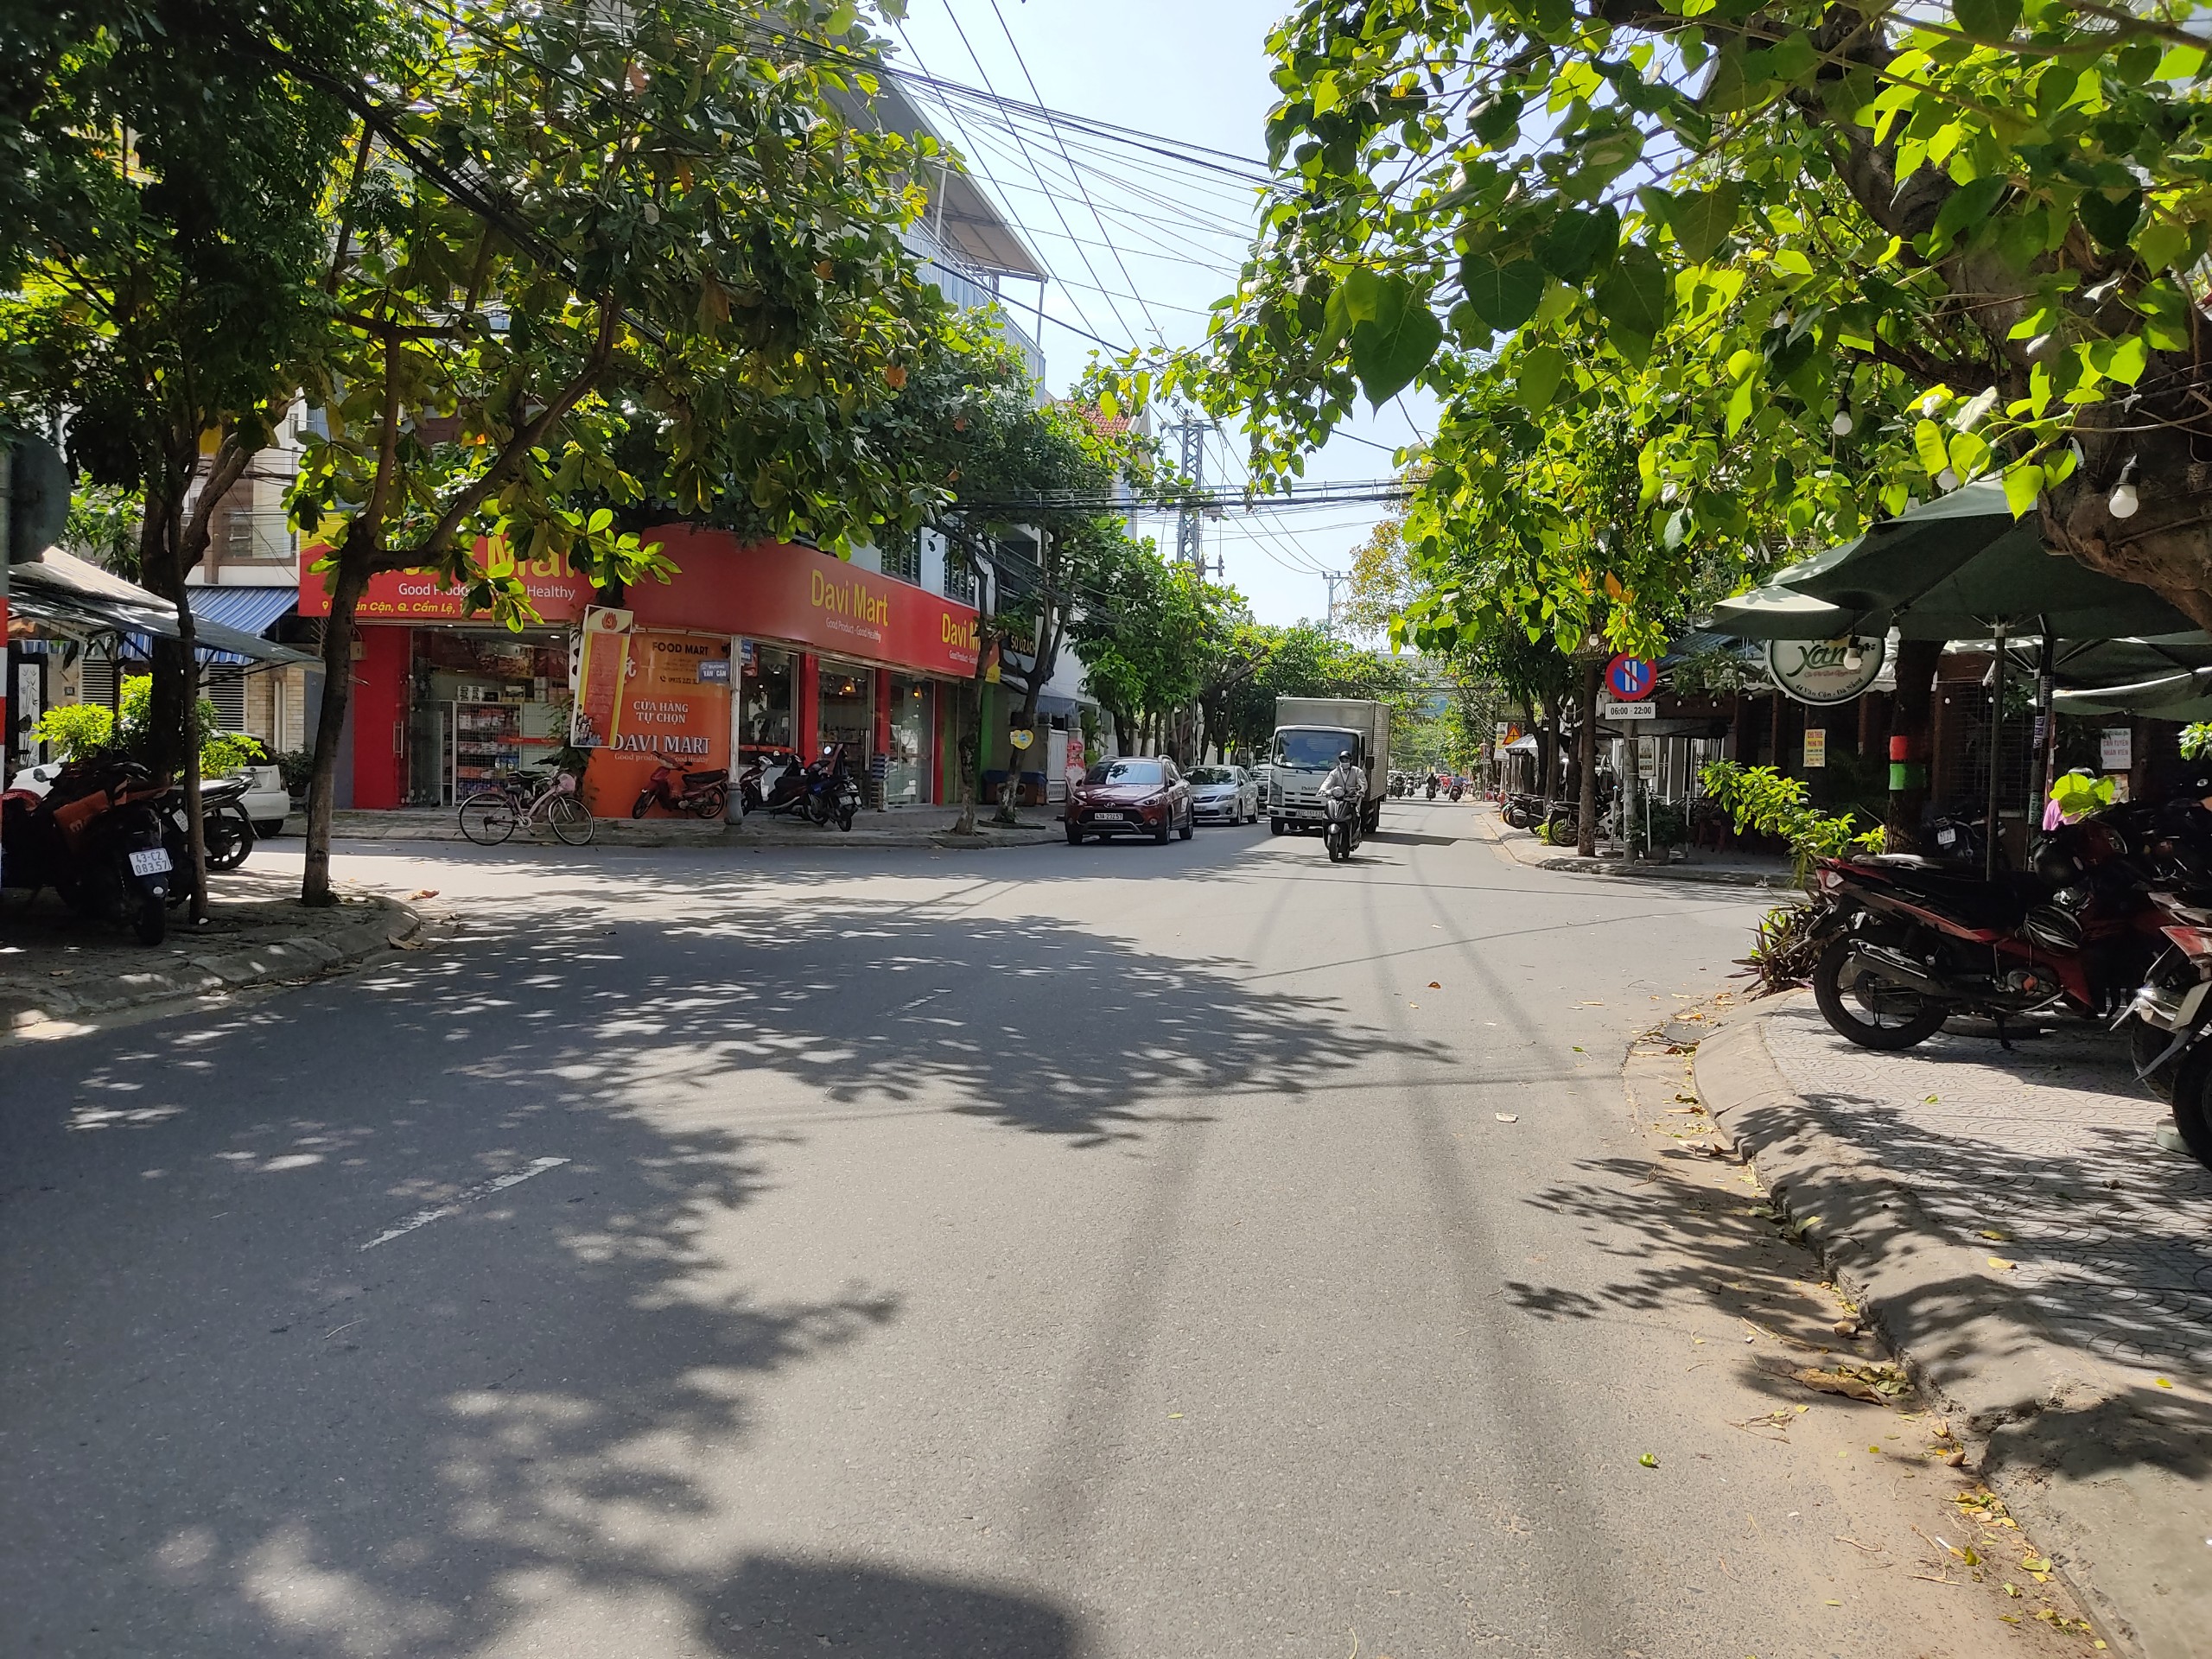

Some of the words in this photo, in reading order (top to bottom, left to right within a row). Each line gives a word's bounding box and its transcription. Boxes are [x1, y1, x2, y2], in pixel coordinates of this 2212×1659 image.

[398, 583, 430, 596] Good
[526, 584, 575, 601] Healthy
[811, 569, 849, 615] Davi
[853, 582, 888, 626] Mart
[826, 617, 838, 630] Good
[838, 620, 854, 634] Product
[856, 625, 867, 638] Good
[942, 613, 968, 649] Davi
[652, 641, 683, 653] FOOD
[684, 645, 709, 656] MART
[633, 698, 657, 711] CỬA
[659, 700, 689, 713] HÀNG
[1610, 707, 1629, 715] 06:00
[1633, 706, 1652, 715] 22:00
[636, 712, 654, 724] TỰ
[656, 713, 685, 725] CHỌN
[609, 734, 658, 753] DAVI
[663, 735, 711, 754] MART
[136, 851, 162, 863] 43-C2
[135, 860, 168, 874] 083.57
